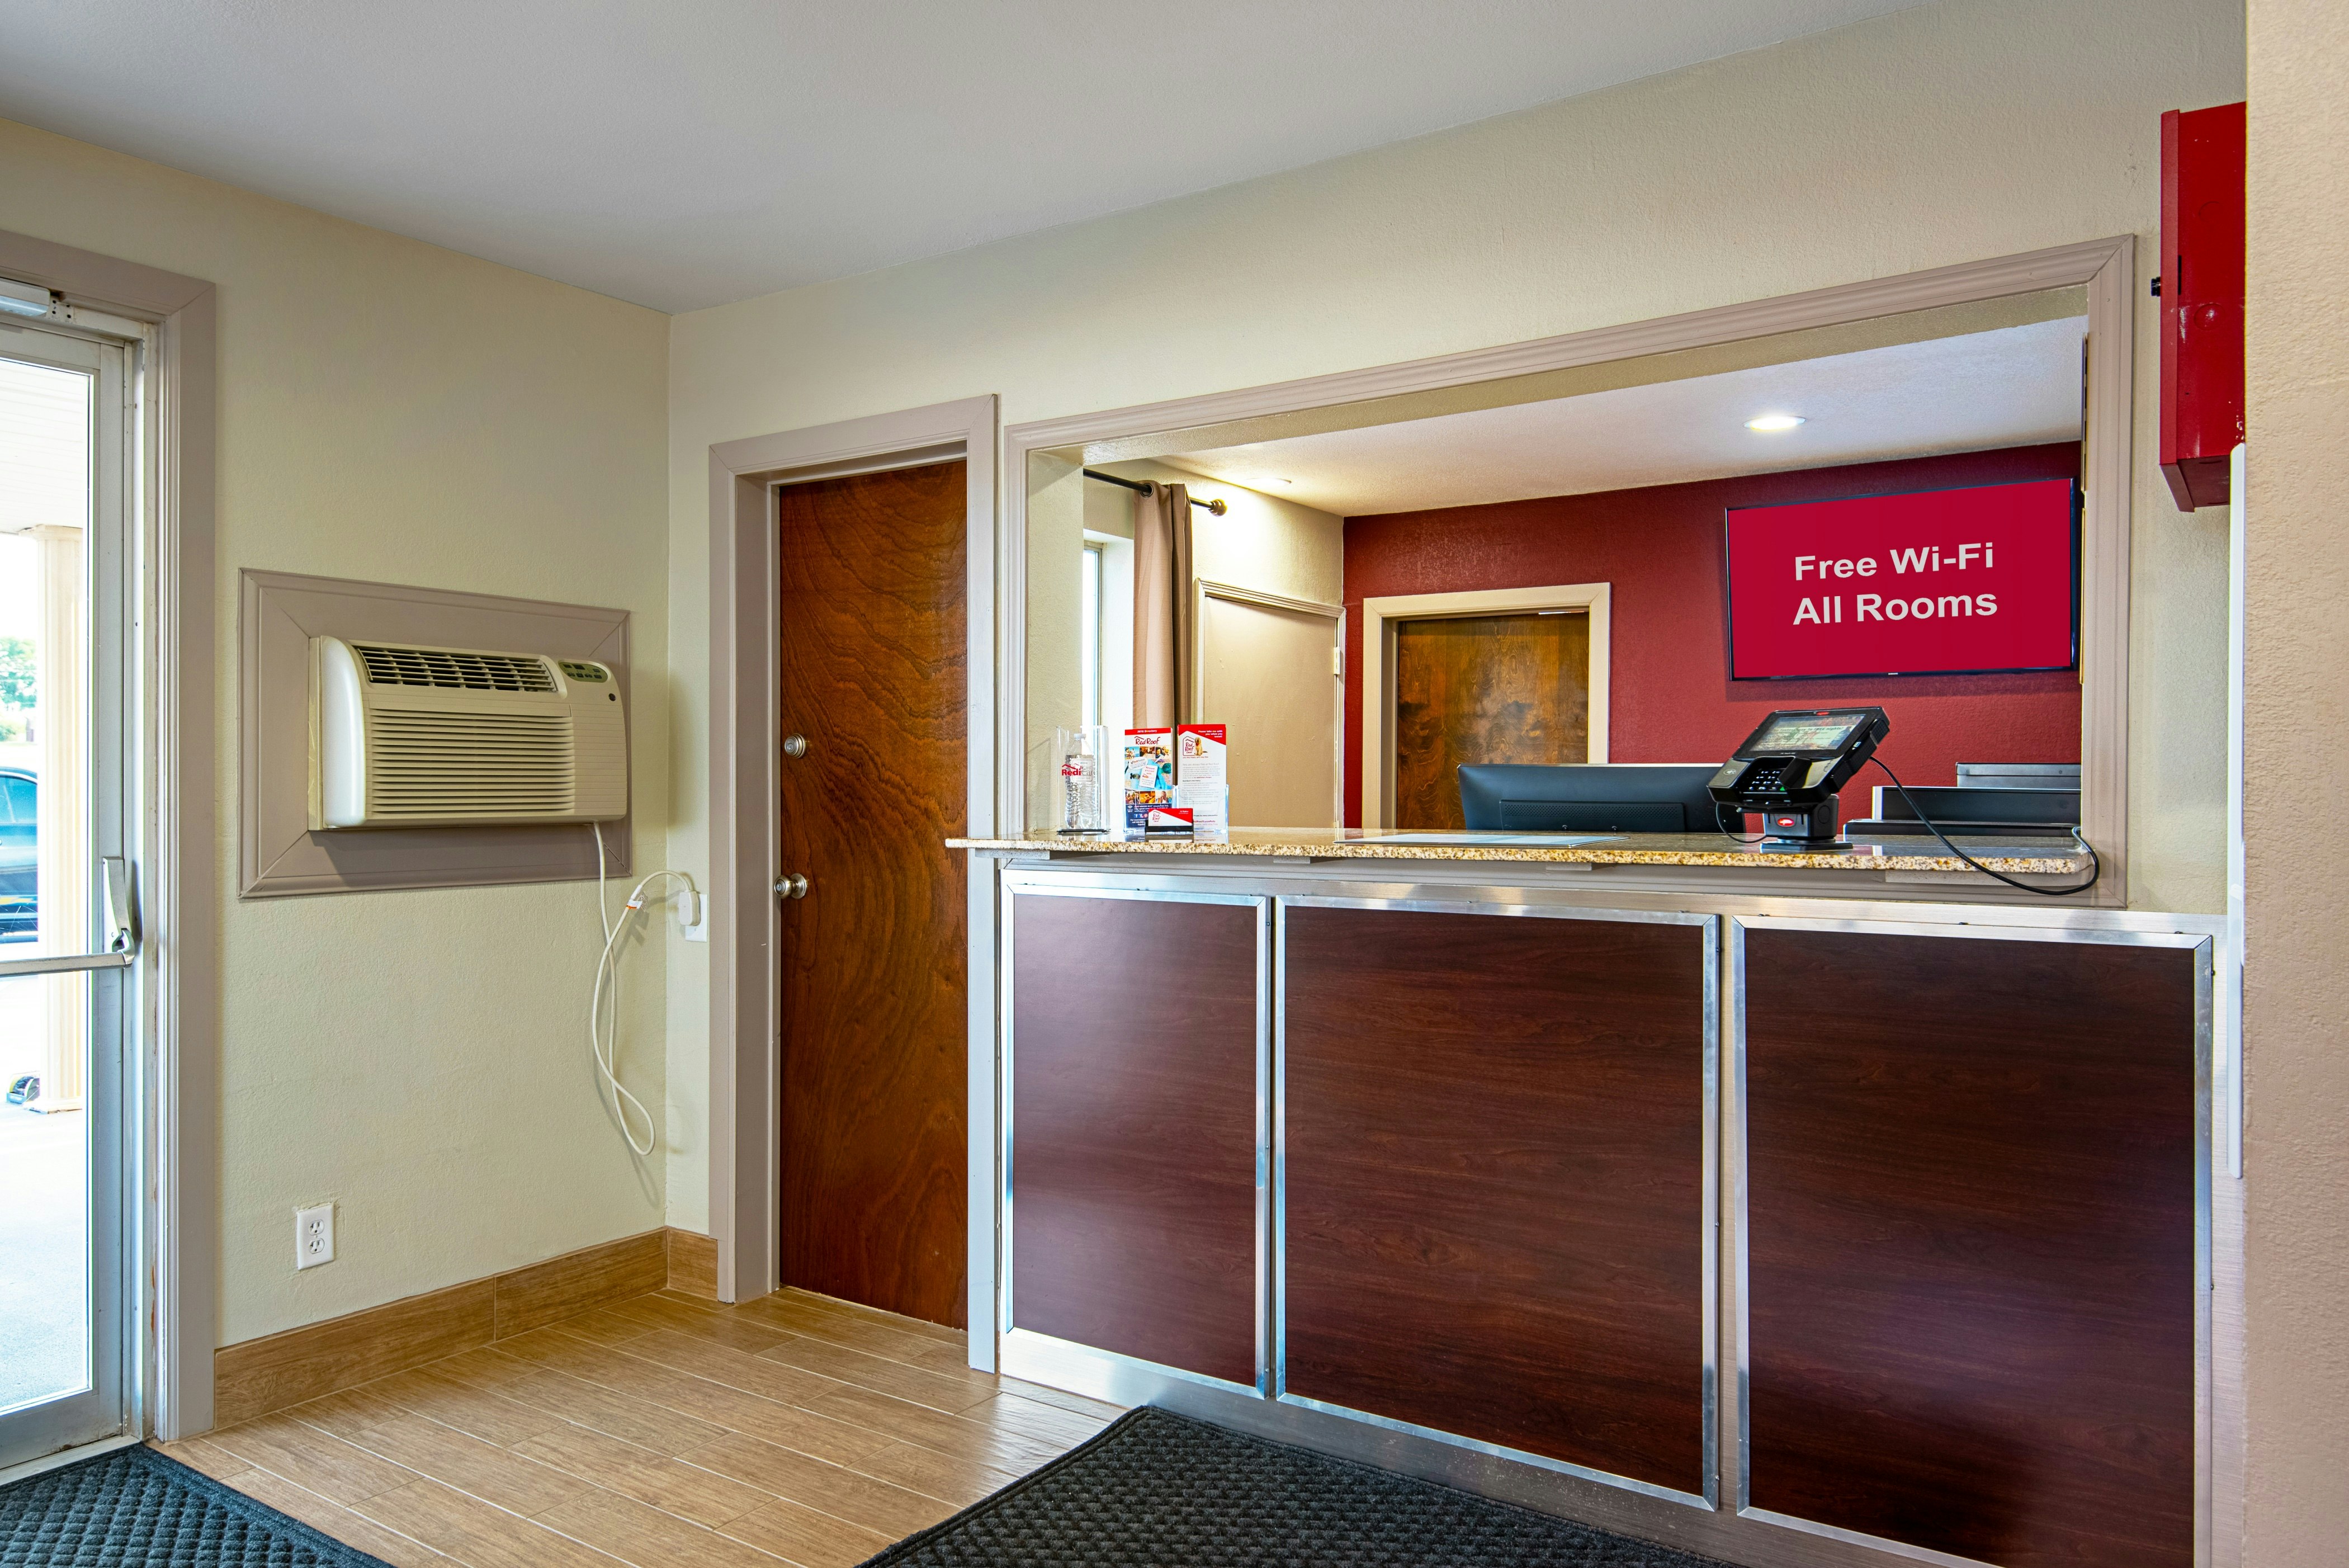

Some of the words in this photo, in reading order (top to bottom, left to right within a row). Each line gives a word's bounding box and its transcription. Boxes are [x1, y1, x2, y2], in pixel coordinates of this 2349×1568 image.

[1795, 556, 1877, 580] Free
[1890, 542, 1992, 573] Wi-Fi
[1793, 596, 1841, 625] All
[1857, 594, 1997, 621] Rooms
[1147, 736, 1161, 745] Roof
